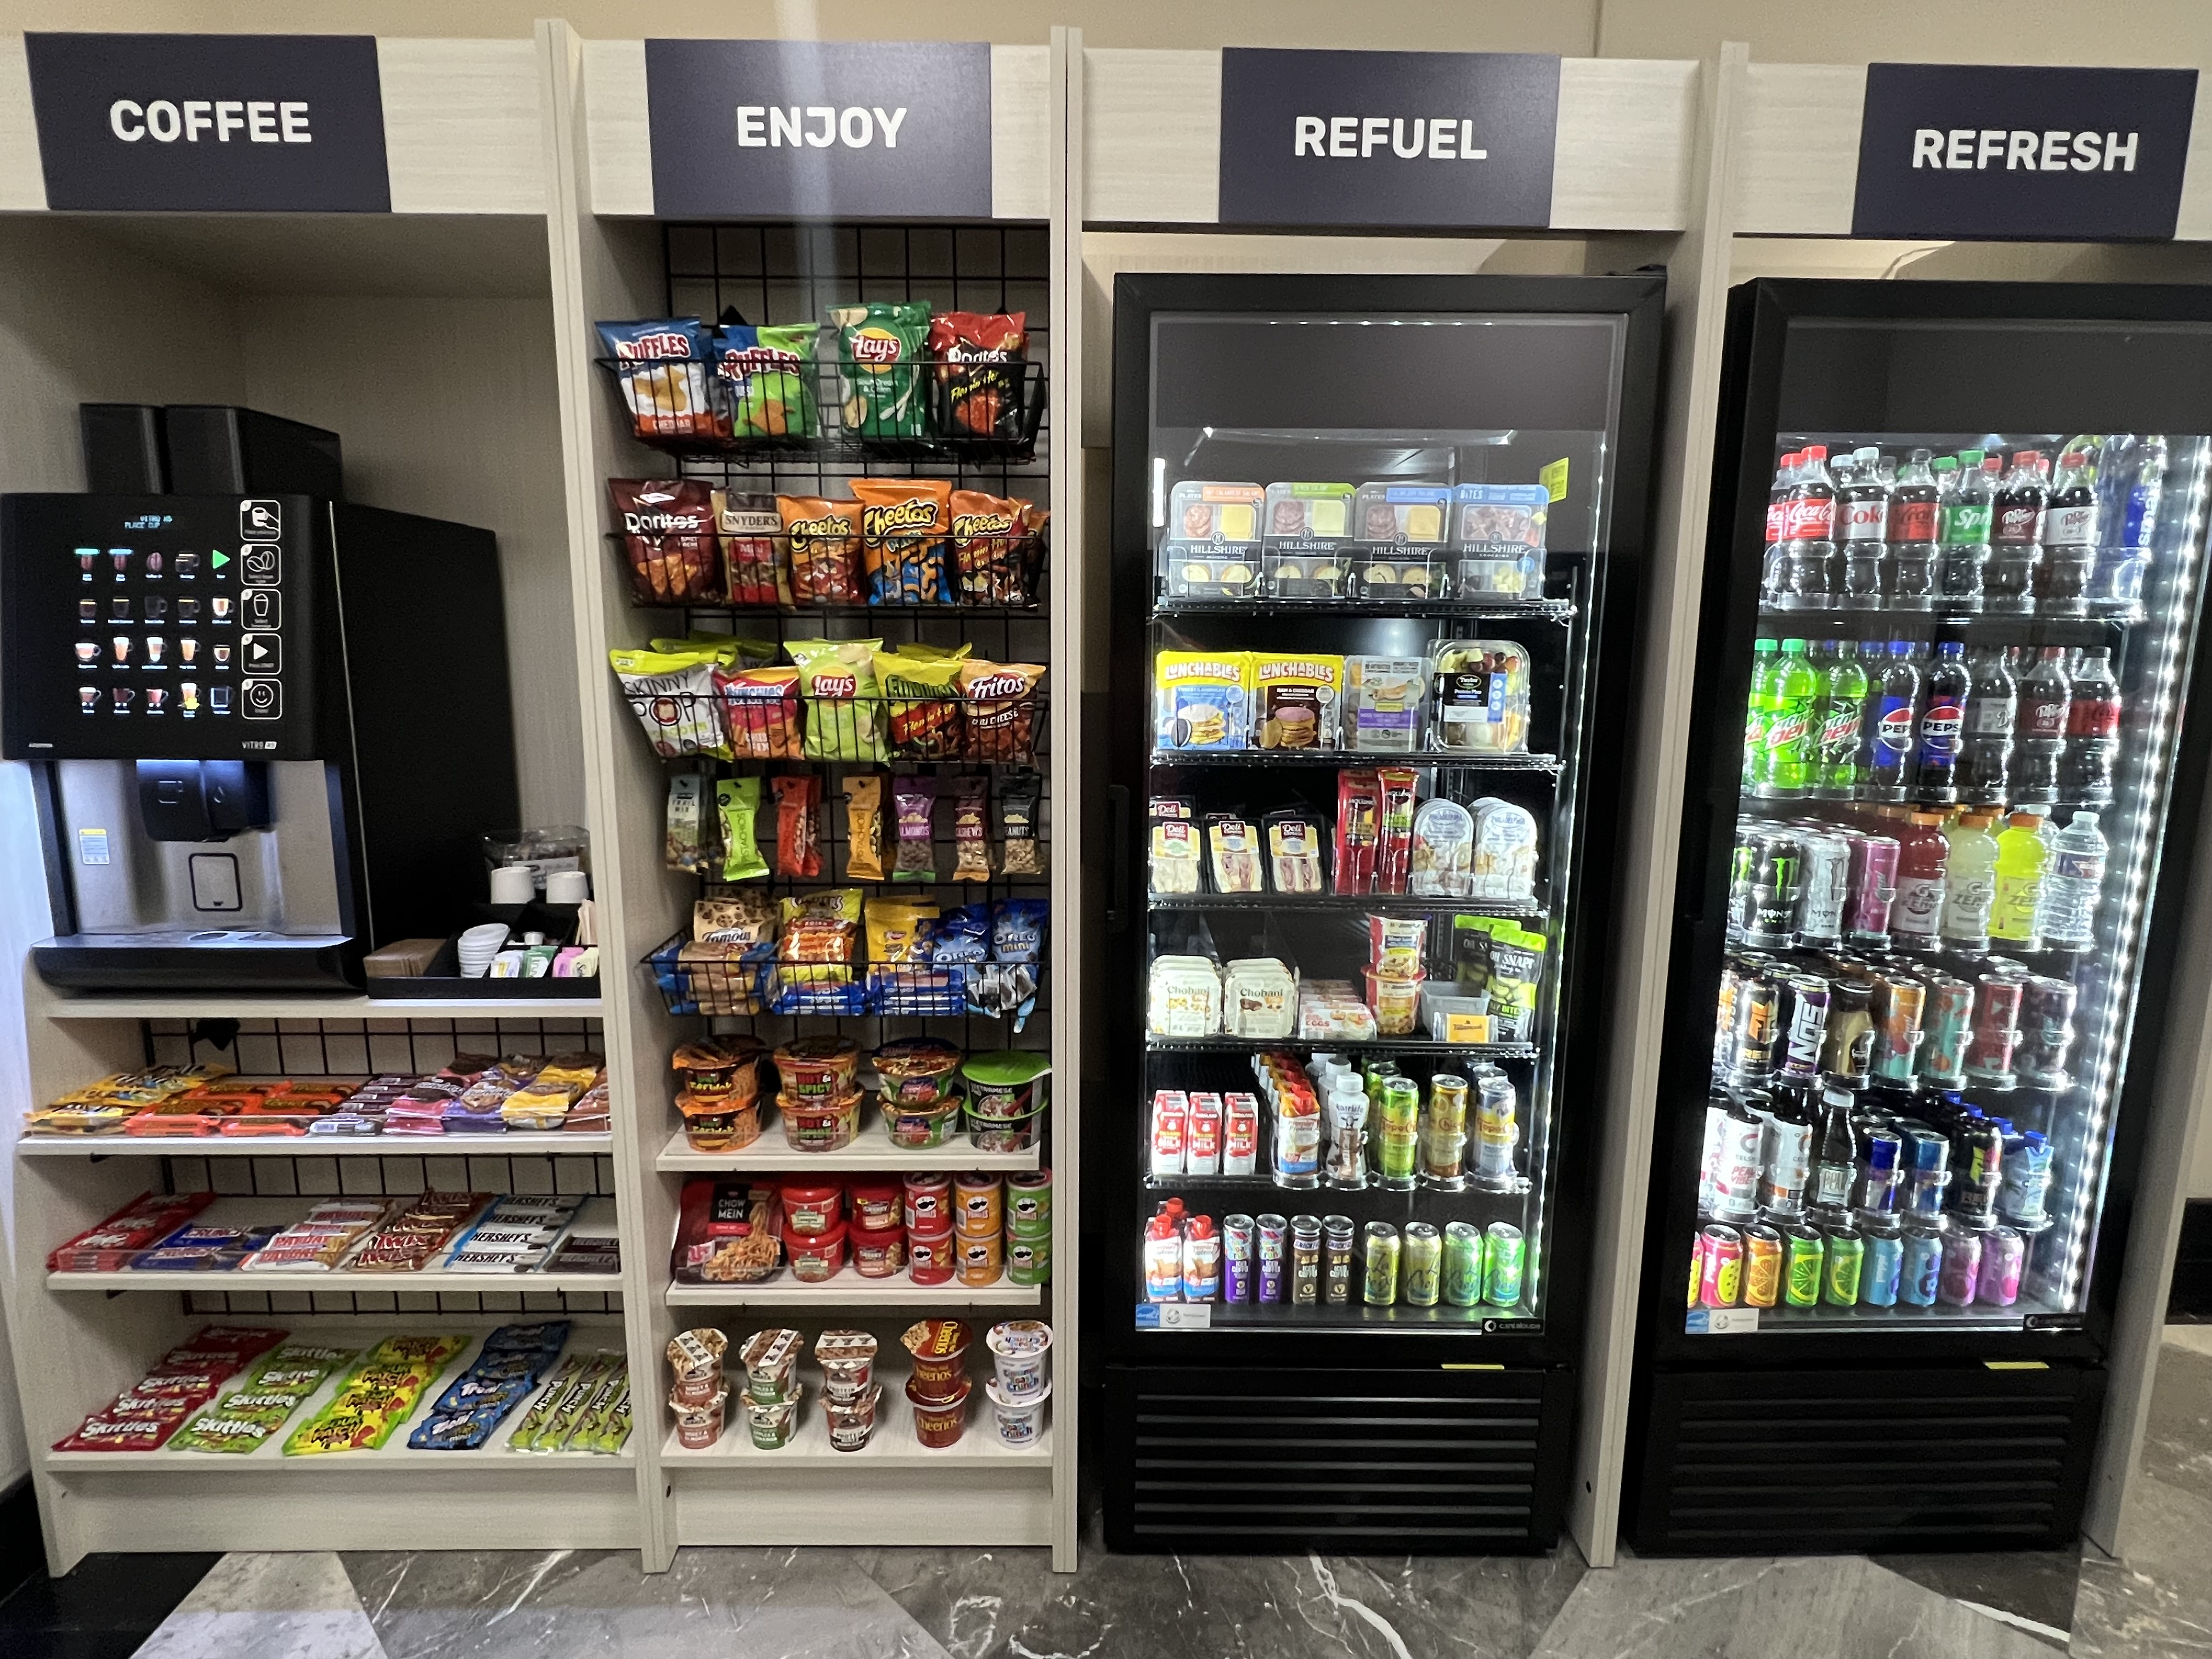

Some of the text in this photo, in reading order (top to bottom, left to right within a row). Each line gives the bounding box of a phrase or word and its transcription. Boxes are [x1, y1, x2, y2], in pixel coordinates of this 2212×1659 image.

[110, 100, 312, 143] COFFEE
[736, 104, 906, 150] ENJOY
[1295, 116, 1488, 160] REFUEL
[1912, 129, 2138, 171] REFRESH
[617, 334, 690, 369] RUFFLES
[947, 348, 1007, 363] Doritos
[725, 347, 800, 380] RUFFLES
[653, 419, 691, 429] CHEDAR
[624, 512, 698, 533] Doritos
[864, 499, 934, 543] Cheetos
[953, 516, 1013, 543] Cheetos
[1190, 544, 1248, 554] HILLSHIRE
[1279, 541, 1335, 551] HILLSHIRE
[1373, 546, 1430, 555] HILLSHIRE
[1463, 543, 1527, 554] HILLSHIRE
[1165, 662, 1241, 682] LUNCHABLES
[1259, 662, 1334, 682] LUNCHABLES
[624, 671, 690, 696] SKINNY
[968, 675, 1024, 703] Fritos
[1882, 724, 1909, 733] PEP
[1923, 722, 1960, 732] PEPS
[1166, 824, 1186, 833] Deli
[1222, 823, 1242, 832] Deli
[1282, 824, 1302, 833] Deli
[702, 928, 752, 943] Famous
[1167, 985, 1210, 995] Chobani
[1240, 988, 1284, 997] Chobani
[799, 1084, 832, 1094] SPICY
[1158, 1137, 1181, 1148] MILK
[1193, 1138, 1216, 1149] MILK
[1228, 1138, 1252, 1150] MILK
[718, 1199, 746, 1208] CHOW
[718, 1208, 744, 1219] MEIN
[470, 1232, 532, 1243] HERSHEY'S
[455, 1253, 518, 1263] HERSHEY'S
[223, 1393, 297, 1409] Skittles
[80, 1420, 159, 1438] Skittles
[190, 1418, 265, 1438] Skittles
